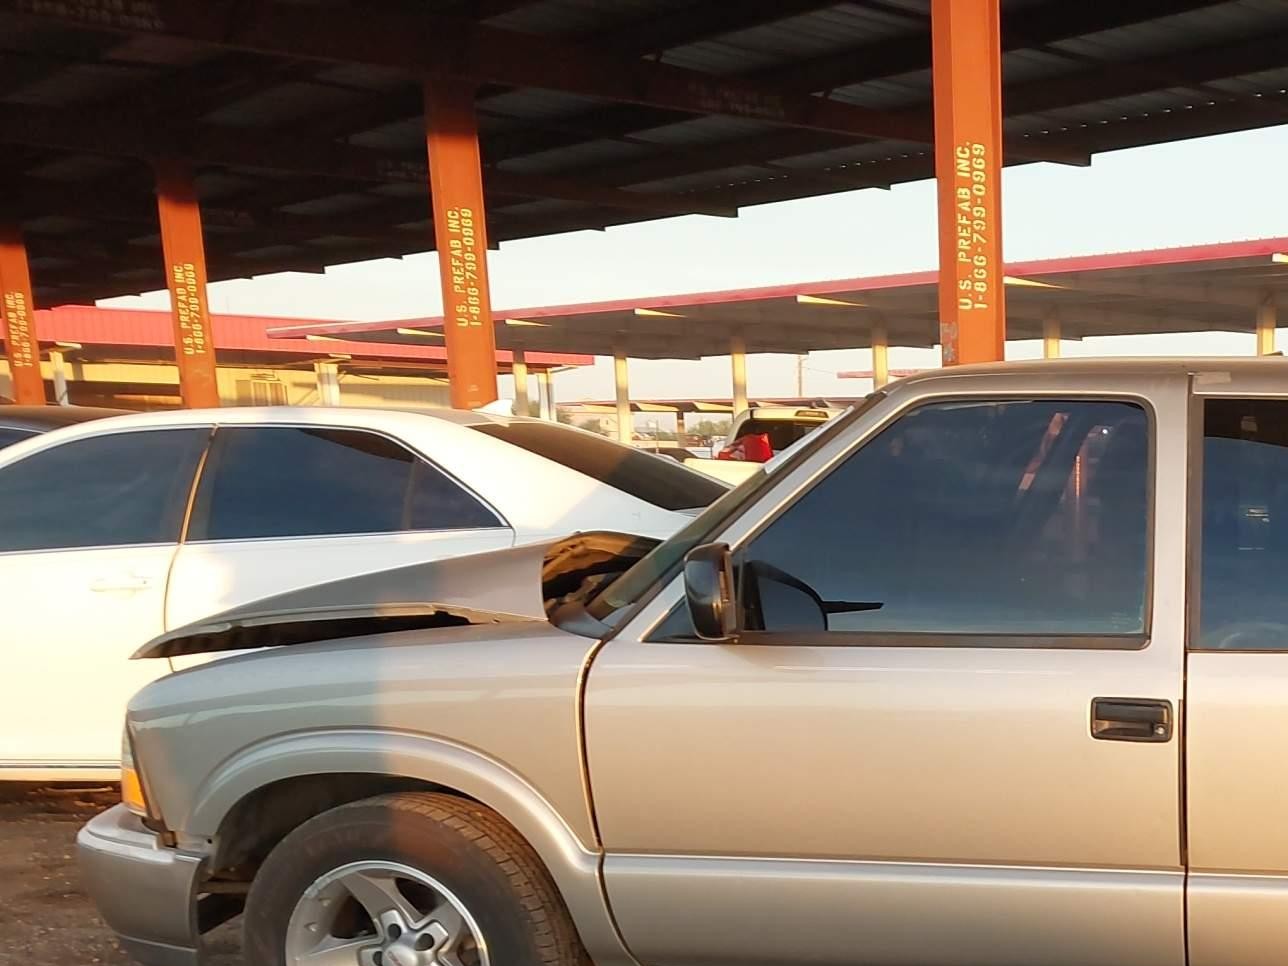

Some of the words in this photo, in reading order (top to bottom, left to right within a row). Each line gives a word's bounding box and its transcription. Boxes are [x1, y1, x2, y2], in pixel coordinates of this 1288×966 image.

[956, 141, 971, 178] INC.
[957, 187, 972, 263] PREFAB
[972, 143, 988, 309] 1-866-799-0969
[449, 239, 466, 293] PREFAB
[958, 274, 973, 310] U.S.
